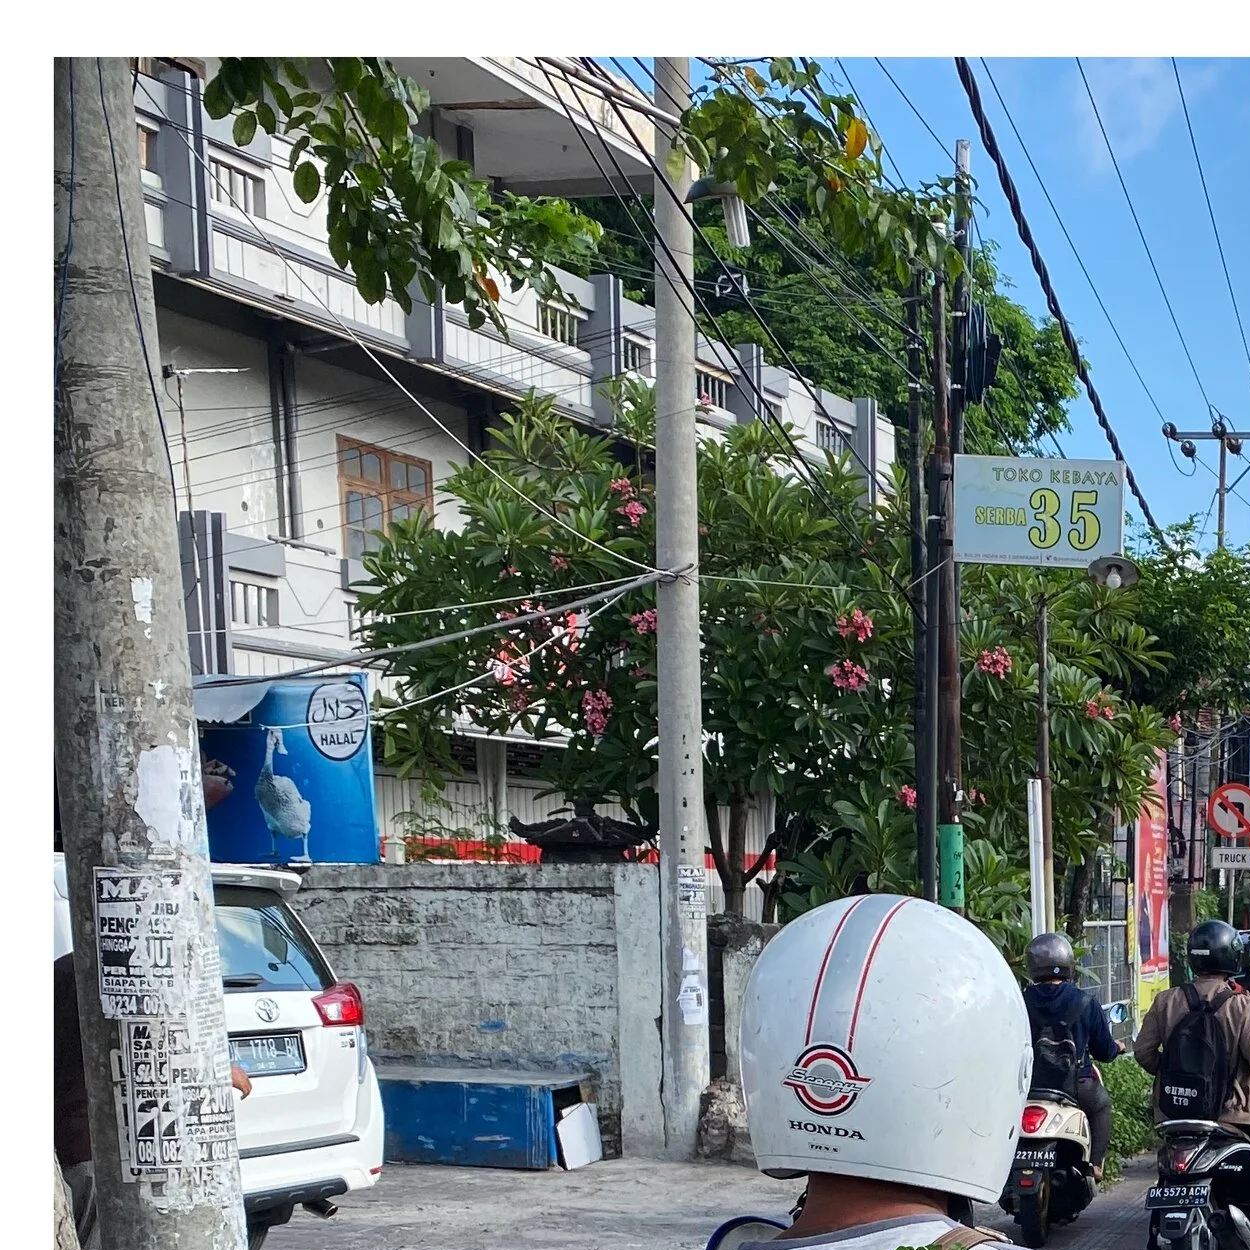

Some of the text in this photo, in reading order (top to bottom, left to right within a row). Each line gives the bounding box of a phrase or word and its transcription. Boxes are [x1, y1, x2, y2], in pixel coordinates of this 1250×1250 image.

[992, 467, 1118, 487] TOKO KEBAYA
[975, 487, 1101, 552] SERBA 35
[319, 733, 358, 747] HALAL
[1219, 852, 1248, 864] TRUCK
[789, 1120, 867, 1141] HONDA
[1150, 1186, 1208, 1198] DK 5573 ACM
